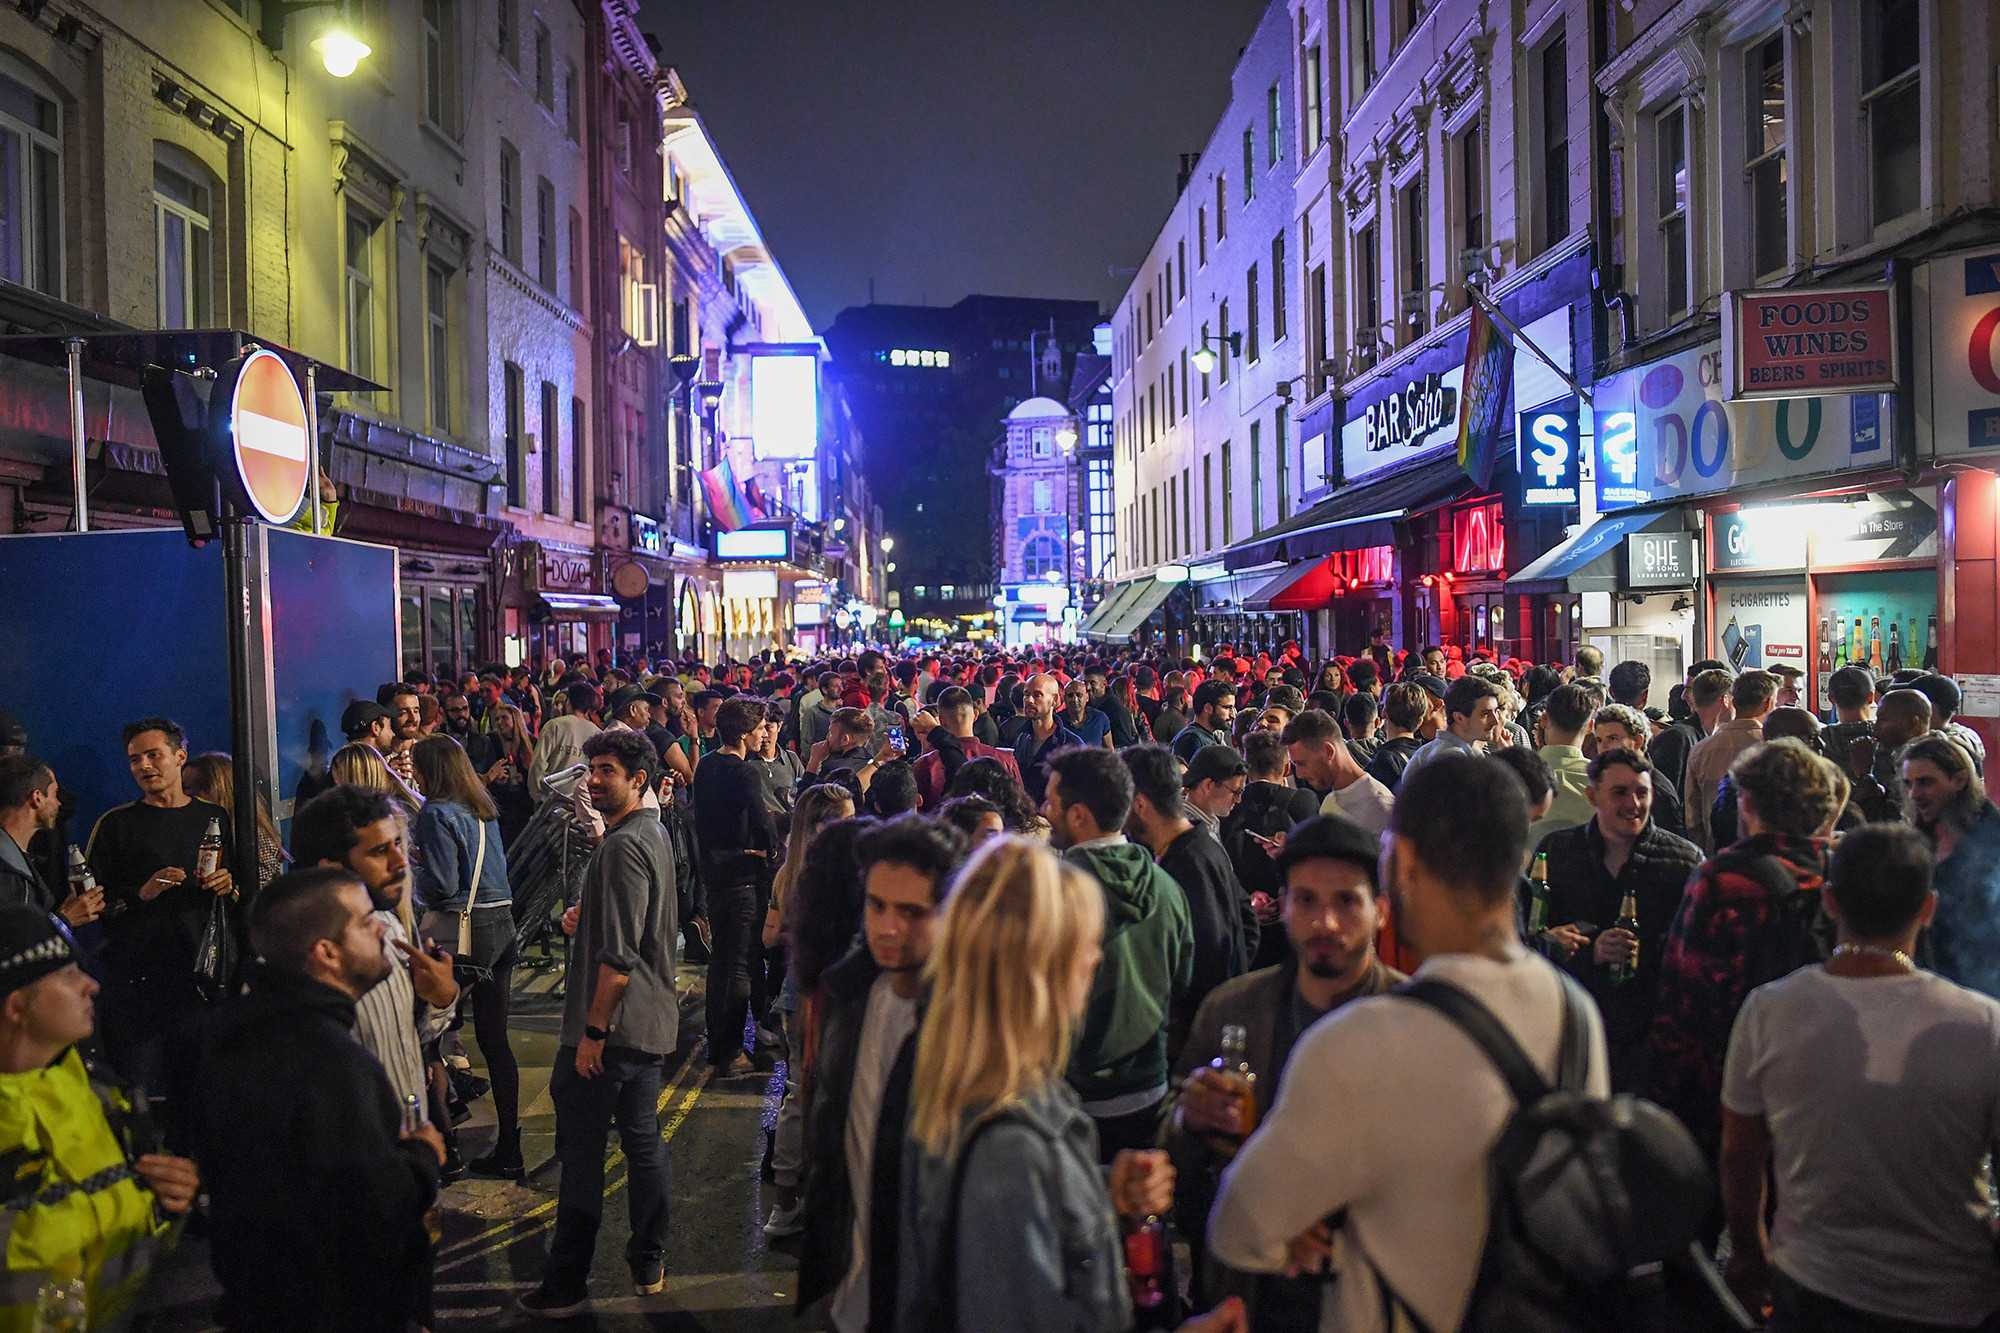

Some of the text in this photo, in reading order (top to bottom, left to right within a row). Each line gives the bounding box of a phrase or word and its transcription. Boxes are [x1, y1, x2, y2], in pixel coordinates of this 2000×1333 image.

[1760, 300, 1869, 328] FOODS
[1764, 330, 1868, 357] WINES
[1750, 360, 1886, 383] BEERS SPIRITS
[1366, 373, 1442, 451] BAR Soho
[1868, 521, 1883, 532] The
[1884, 519, 1904, 531] Store
[1644, 540, 1679, 567] SHE
[551, 559, 586, 584] DOZO
[1730, 592, 1790, 607] E-CIGARETTES
